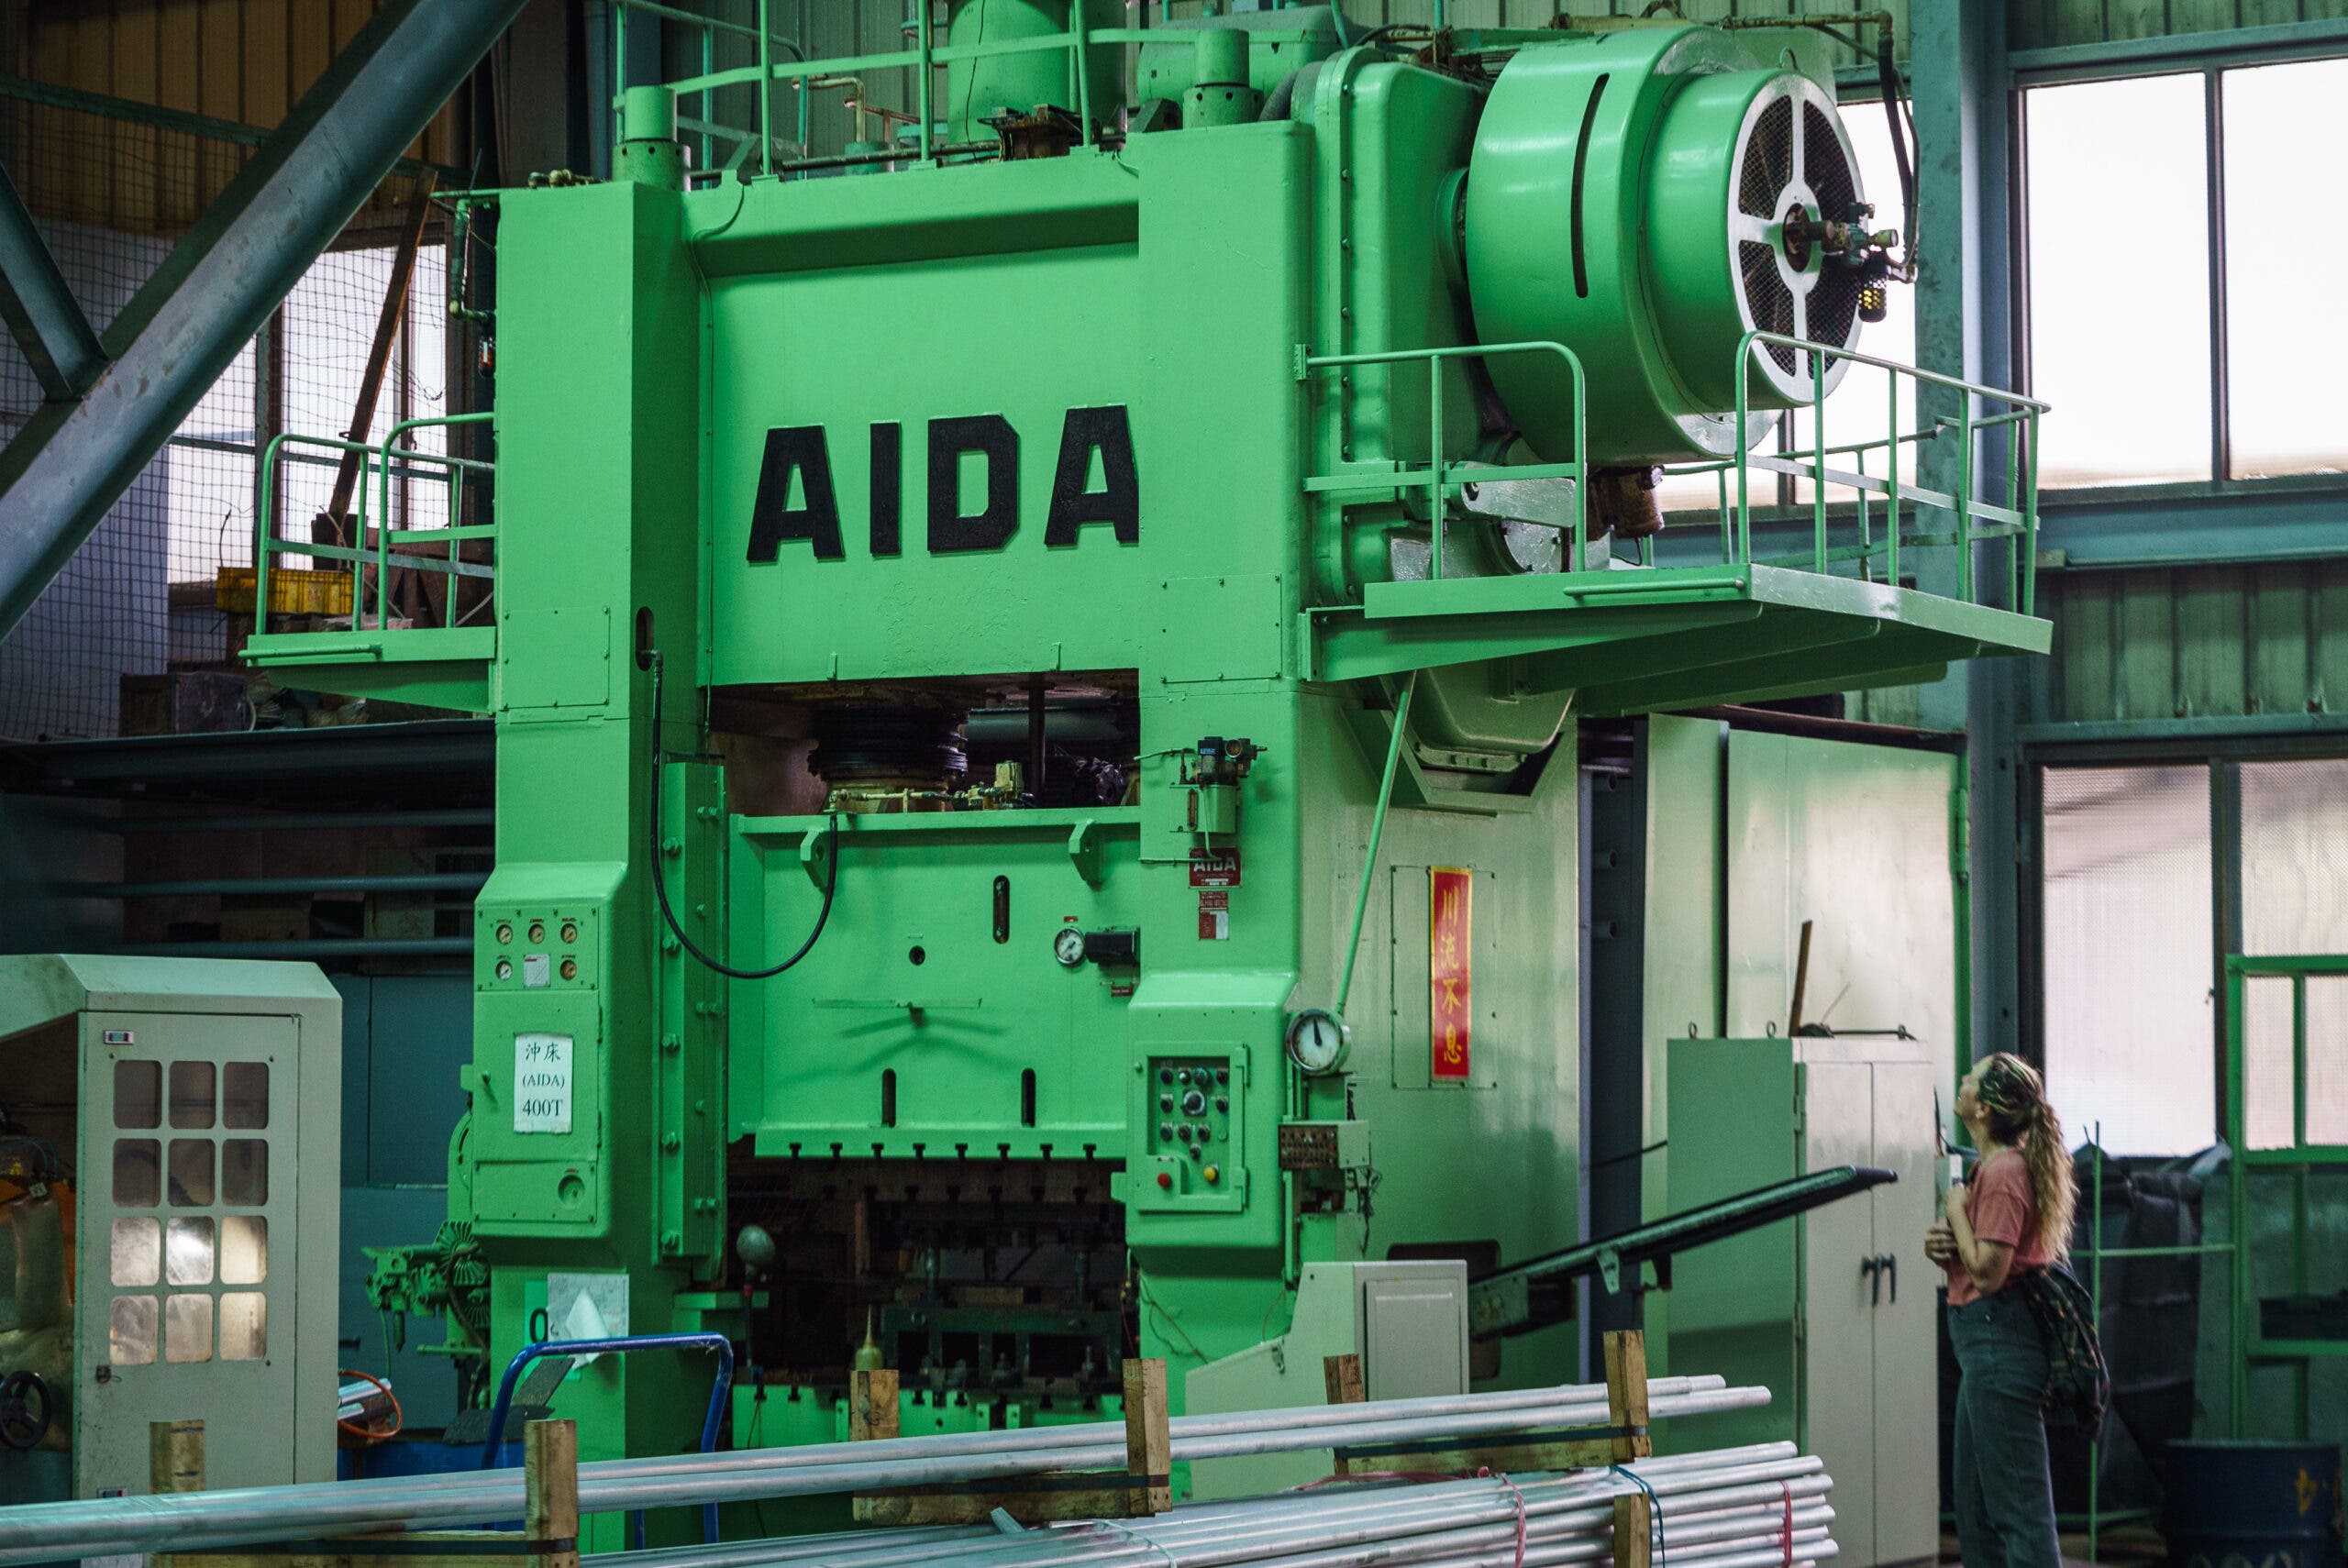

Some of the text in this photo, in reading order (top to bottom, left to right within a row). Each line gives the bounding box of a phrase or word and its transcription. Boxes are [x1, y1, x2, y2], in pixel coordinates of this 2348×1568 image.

[747, 403, 1139, 563] AIDA
[1440, 885, 1462, 1065] 川流不息
[526, 1042, 561, 1062] 沖床
[522, 1073, 565, 1089] (AIDA)
[522, 1099, 563, 1117] 400T
